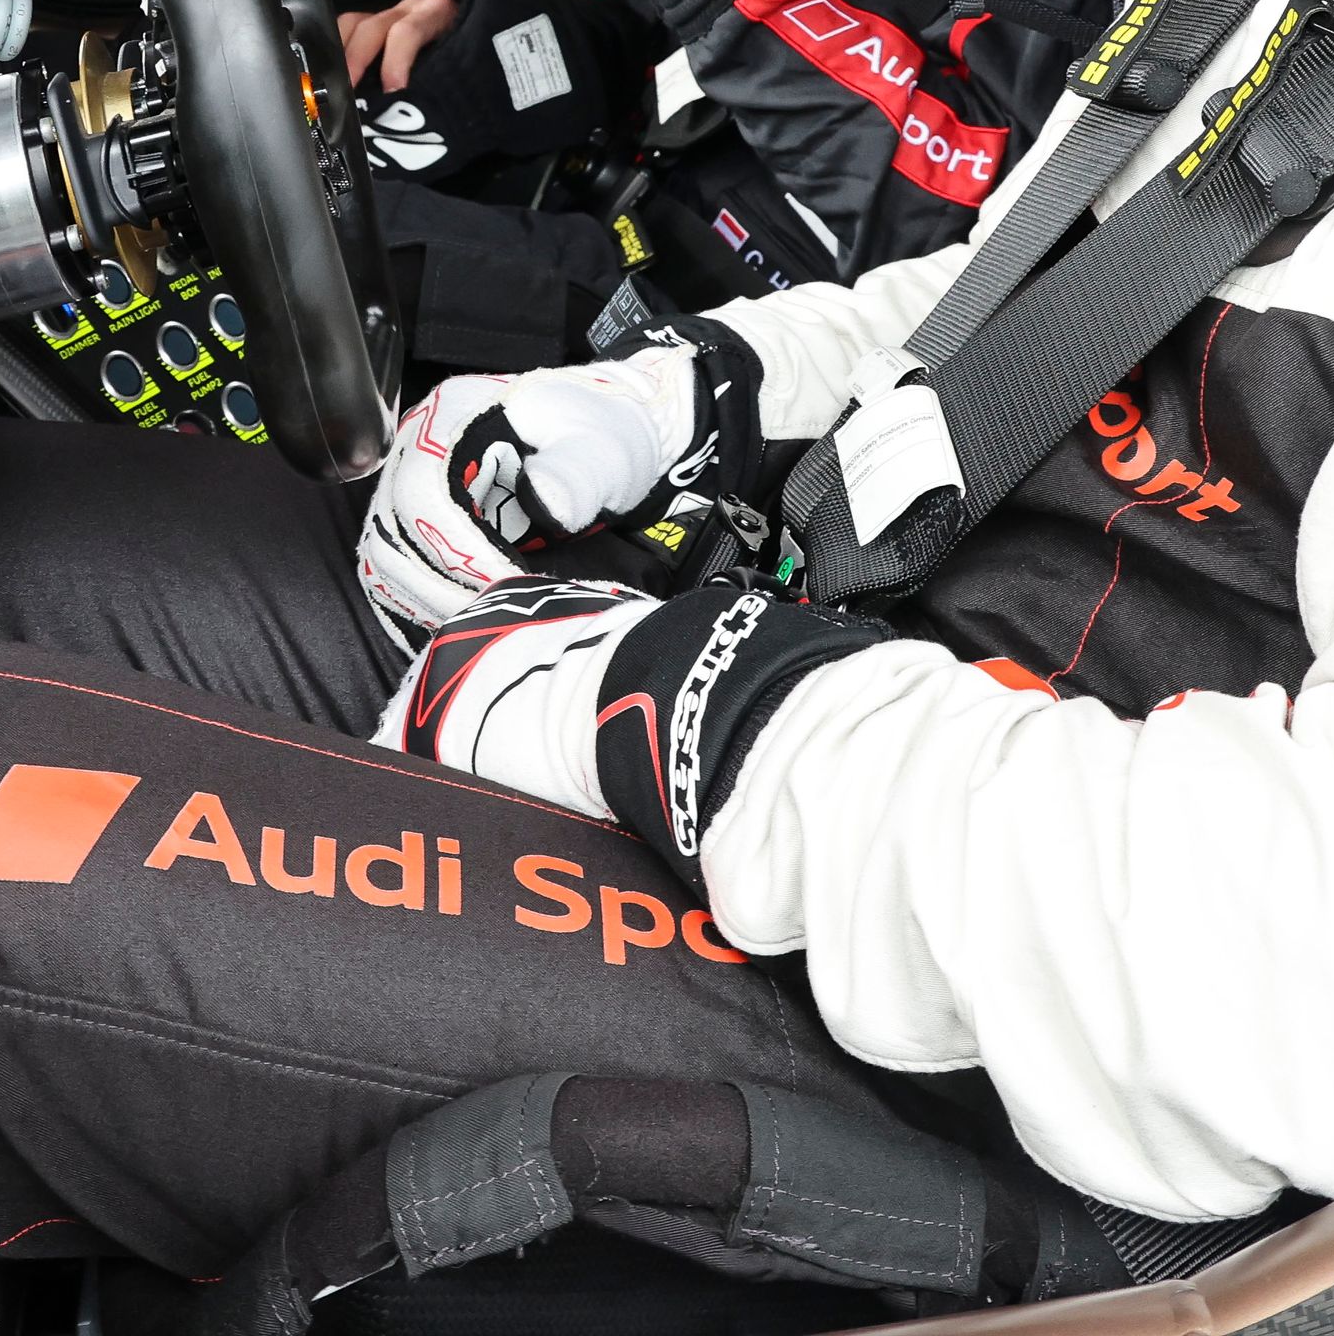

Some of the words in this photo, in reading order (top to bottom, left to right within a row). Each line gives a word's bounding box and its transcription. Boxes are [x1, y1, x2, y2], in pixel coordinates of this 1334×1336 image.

[1176, 7, 1300, 180] SCHROTH
[169, 272, 200, 293] PEDAL
[180, 285, 201, 301] BOX
[109, 312, 136, 334] RAIN
[135, 299, 163, 321] LIGHT
[59, 332, 102, 361] DIMMER
[187, 371, 212, 389] FUEL
[191, 377, 224, 402] PUMP2
[133, 400, 159, 420] FUEL
[143, 790, 463, 917] Audi
